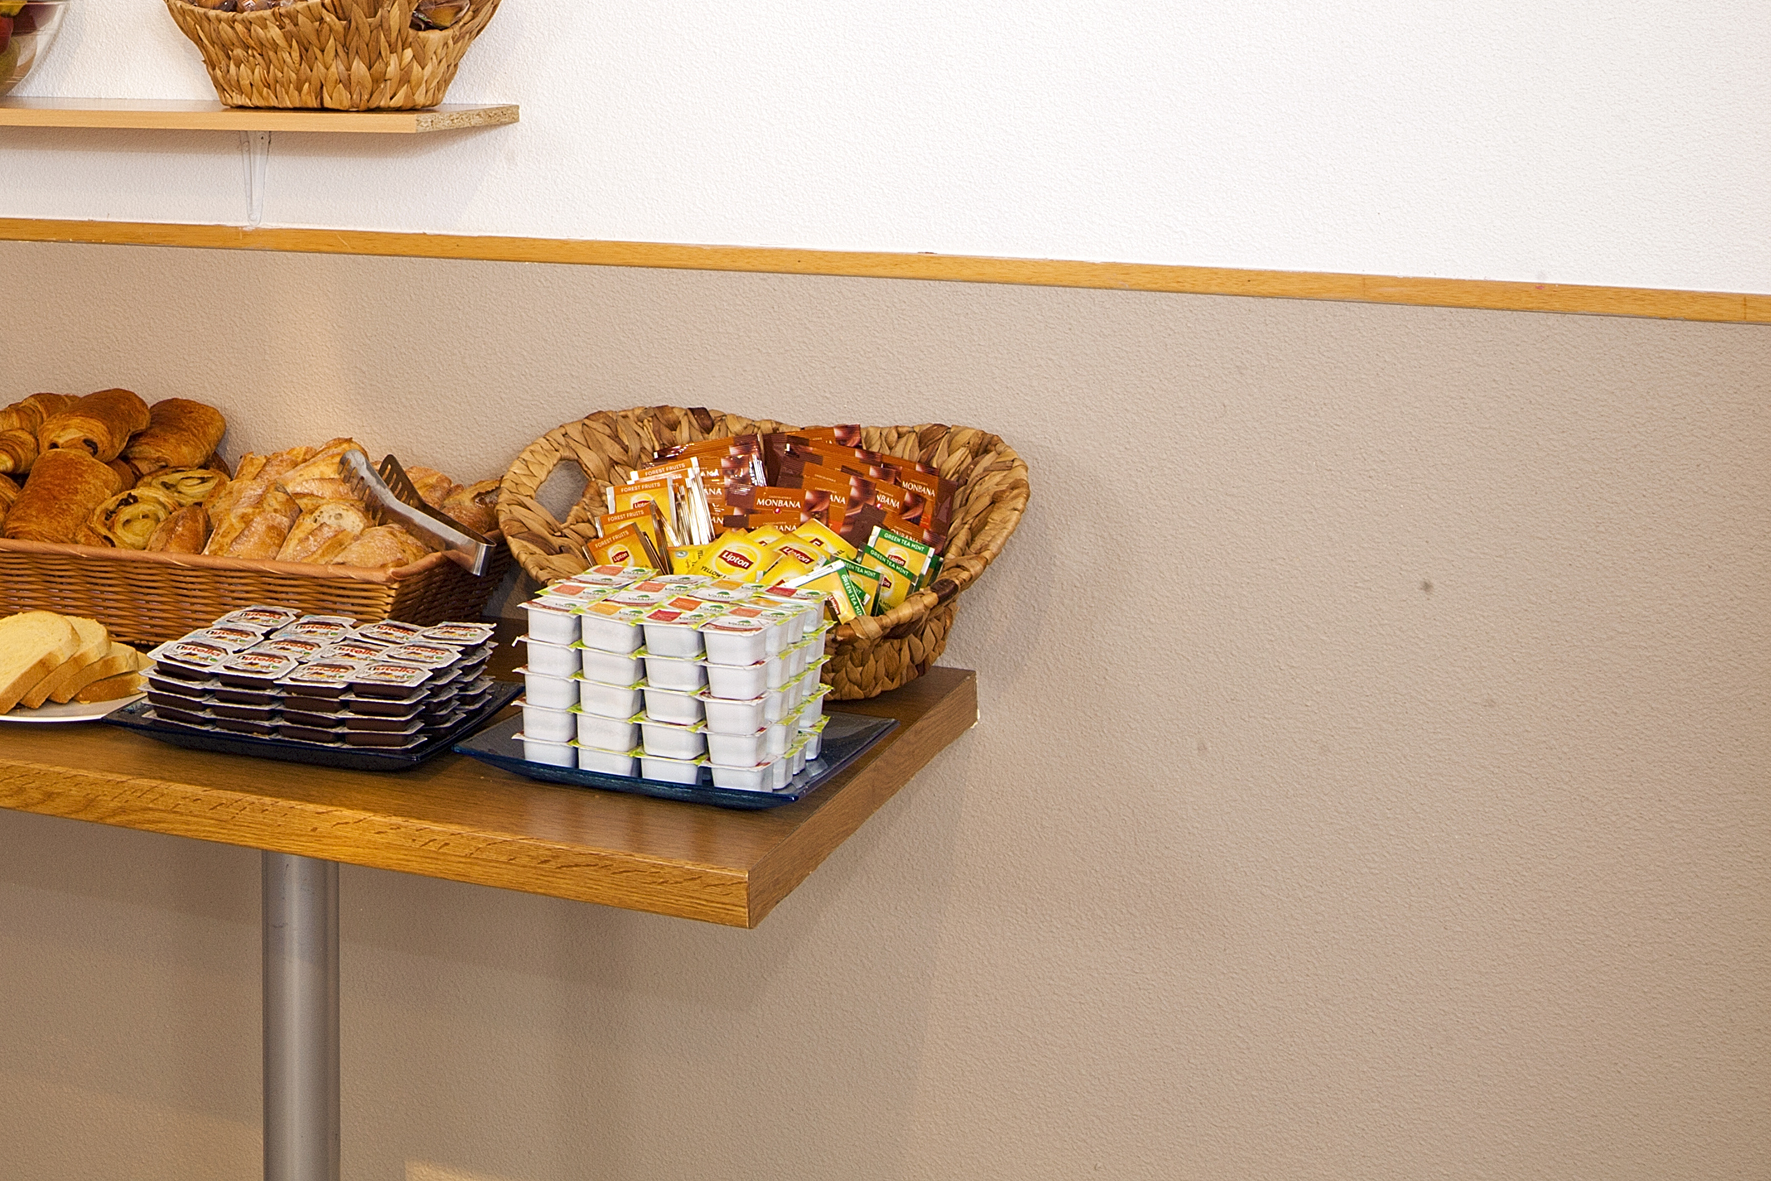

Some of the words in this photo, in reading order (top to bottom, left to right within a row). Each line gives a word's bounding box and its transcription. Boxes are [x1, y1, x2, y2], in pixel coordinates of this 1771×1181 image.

[644, 468, 665, 476] FOREST
[665, 462, 686, 473] FRUITS
[620, 484, 641, 493] FOREST
[641, 481, 661, 489] FRUITS
[902, 480, 936, 497] MONBANA
[756, 498, 802, 508] MONBANA
[607, 513, 627, 522] FOREST
[626, 509, 645, 518] FRUITS
[594, 539, 613, 549] FOREST
[612, 530, 629, 541] FRUITS
[883, 532, 902, 543] GREEN
[901, 539, 911, 547] TEA
[910, 541, 926, 552] MINT
[613, 552, 629, 562] Lipton
[721, 551, 750, 568] Lipton
[870, 549, 887, 563] GREEN
[886, 558, 897, 569] TEA
[895, 564, 910, 577] MINT
[701, 565, 723, 579] YELLOW
[854, 565, 864, 574] TEA
[863, 568, 877, 578] MINT
[841, 575, 852, 594] GREEN
[849, 593, 859, 606] TEA
[240, 611, 282, 620] nutella
[295, 623, 339, 631] nutella
[373, 624, 415, 637] nutella
[206, 629, 250, 639] nutella
[176, 644, 221, 658] nutella
[334, 646, 377, 657] nutella
[399, 645, 445, 655] nutella
[237, 654, 283, 665] nutella
[369, 666, 415, 675] nutella
